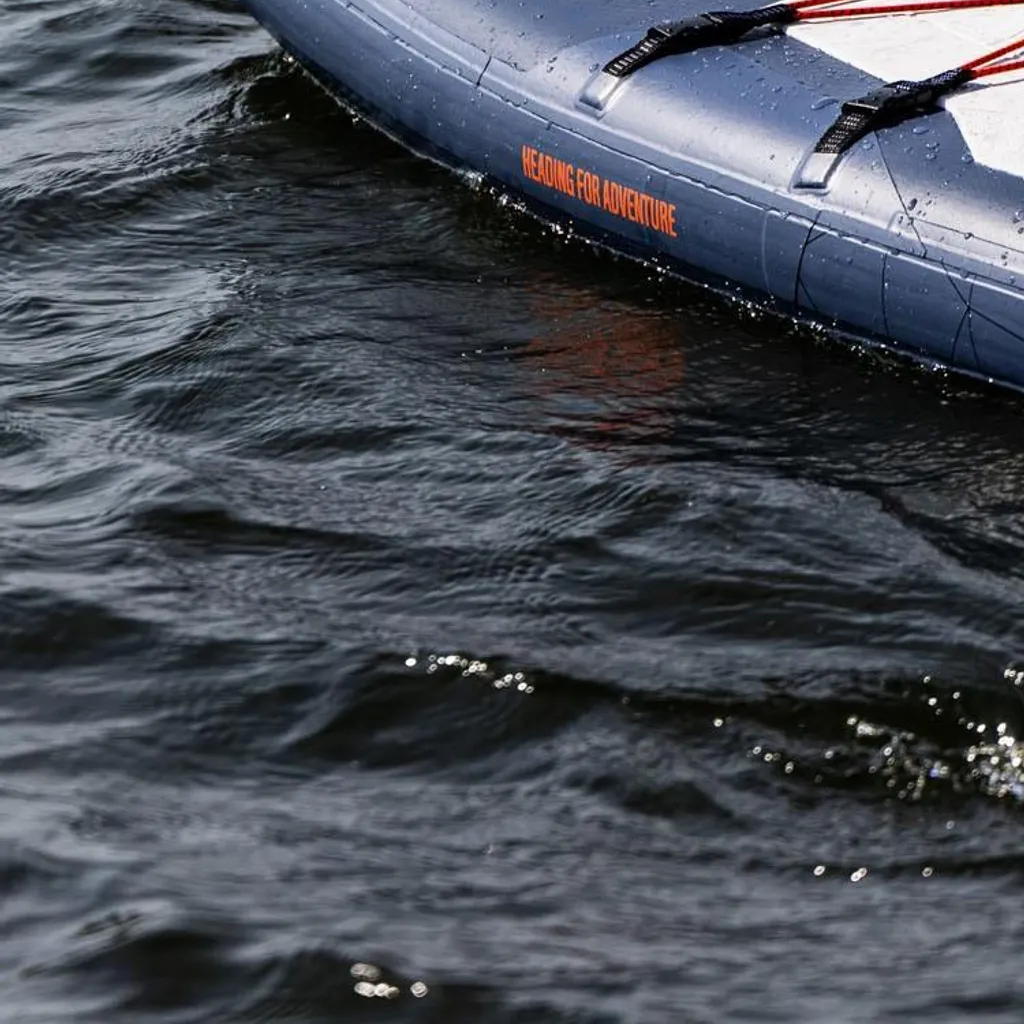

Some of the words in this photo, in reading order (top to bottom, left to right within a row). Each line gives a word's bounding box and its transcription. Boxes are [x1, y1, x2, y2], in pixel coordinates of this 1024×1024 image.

[521, 144, 575, 197] HEADING
[576, 168, 601, 207] FOR
[603, 179, 678, 238] ADVENTURE
